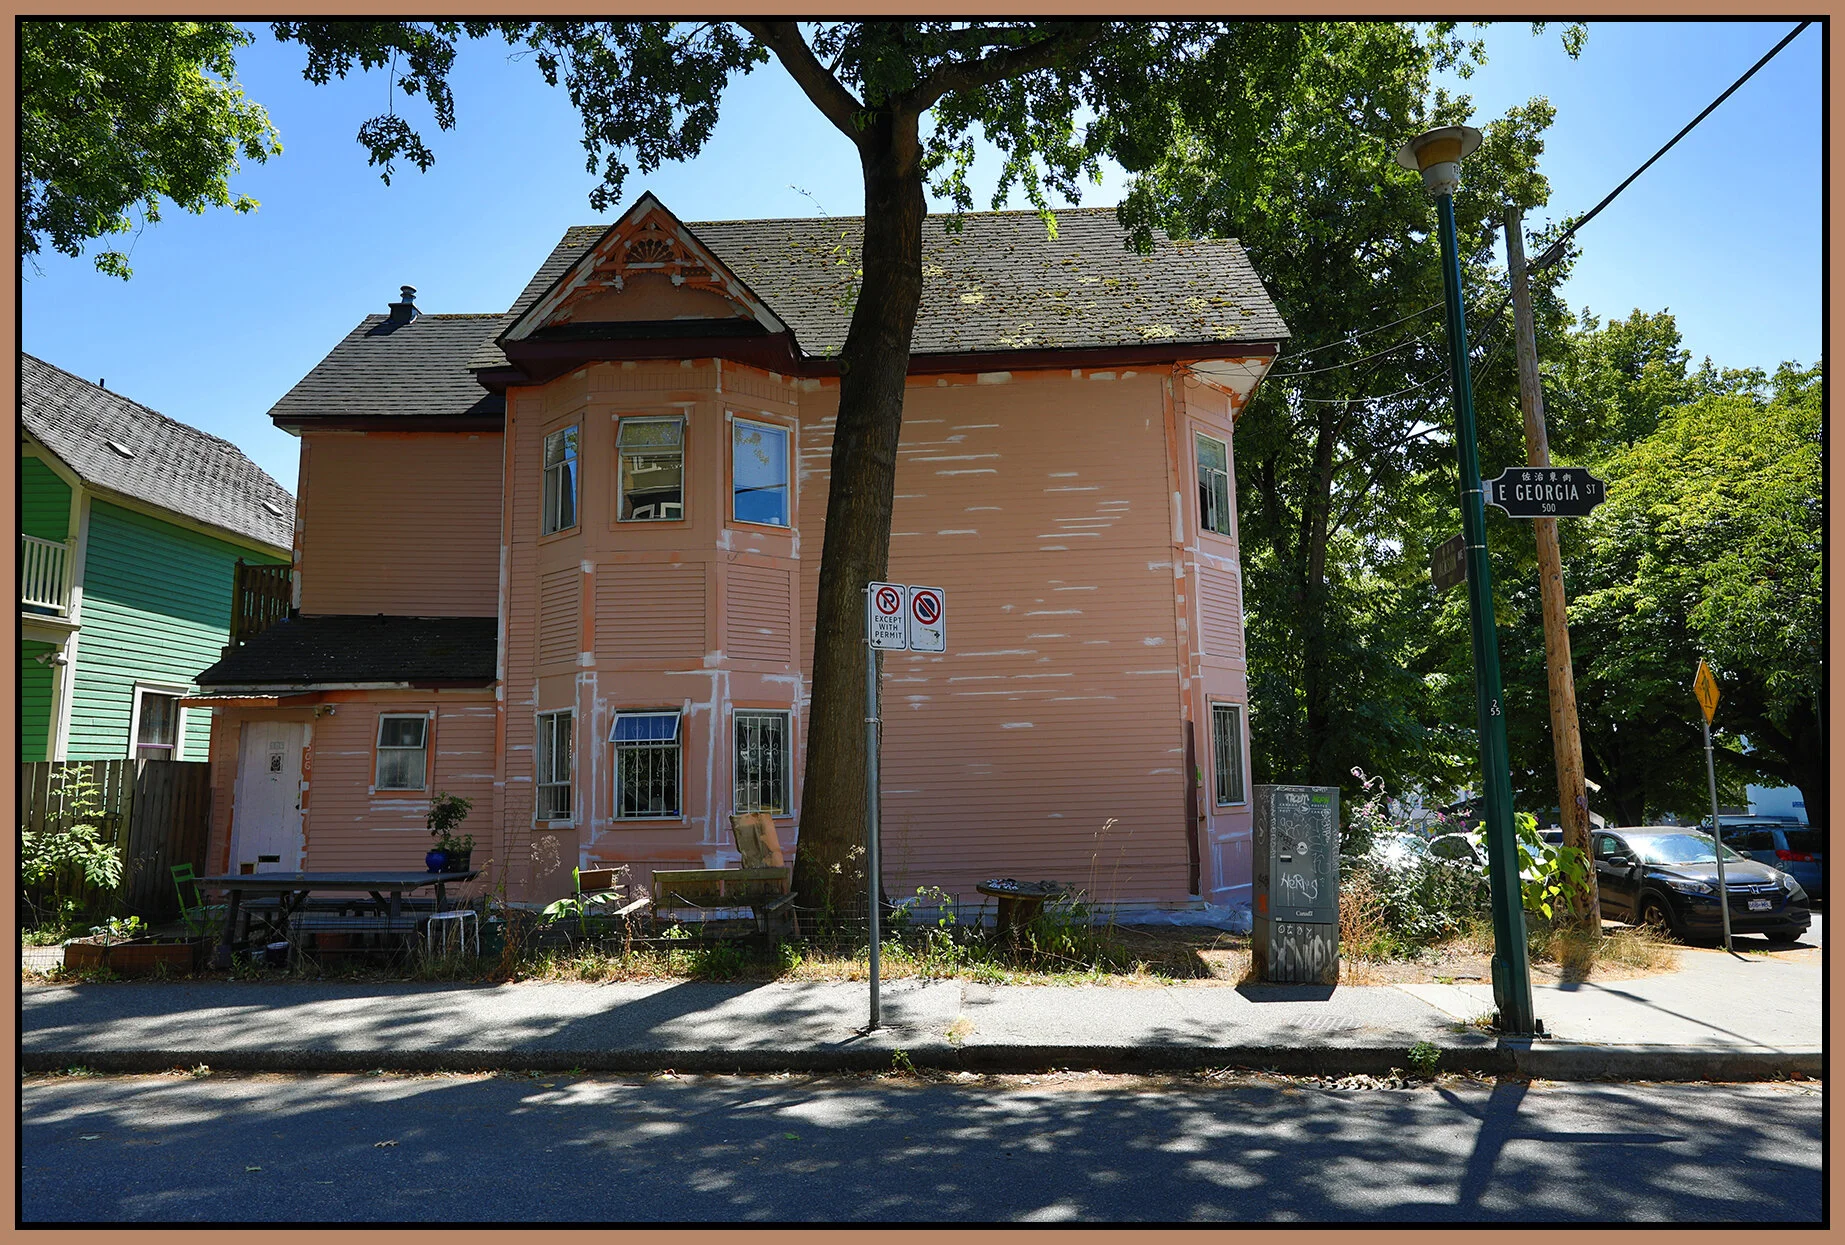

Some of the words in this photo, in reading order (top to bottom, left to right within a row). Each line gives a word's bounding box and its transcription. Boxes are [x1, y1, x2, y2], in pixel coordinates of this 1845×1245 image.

[1499, 484, 1507, 501] E
[1515, 484, 1579, 501] GEORGIA
[1585, 483, 1596, 495] ST
[1541, 503, 1556, 513] 500
[875, 615, 902, 623] EXCEPT
[875, 631, 902, 639] PERMIT
[1492, 699, 1498, 707] 2
[1490, 707, 1501, 715] 55
